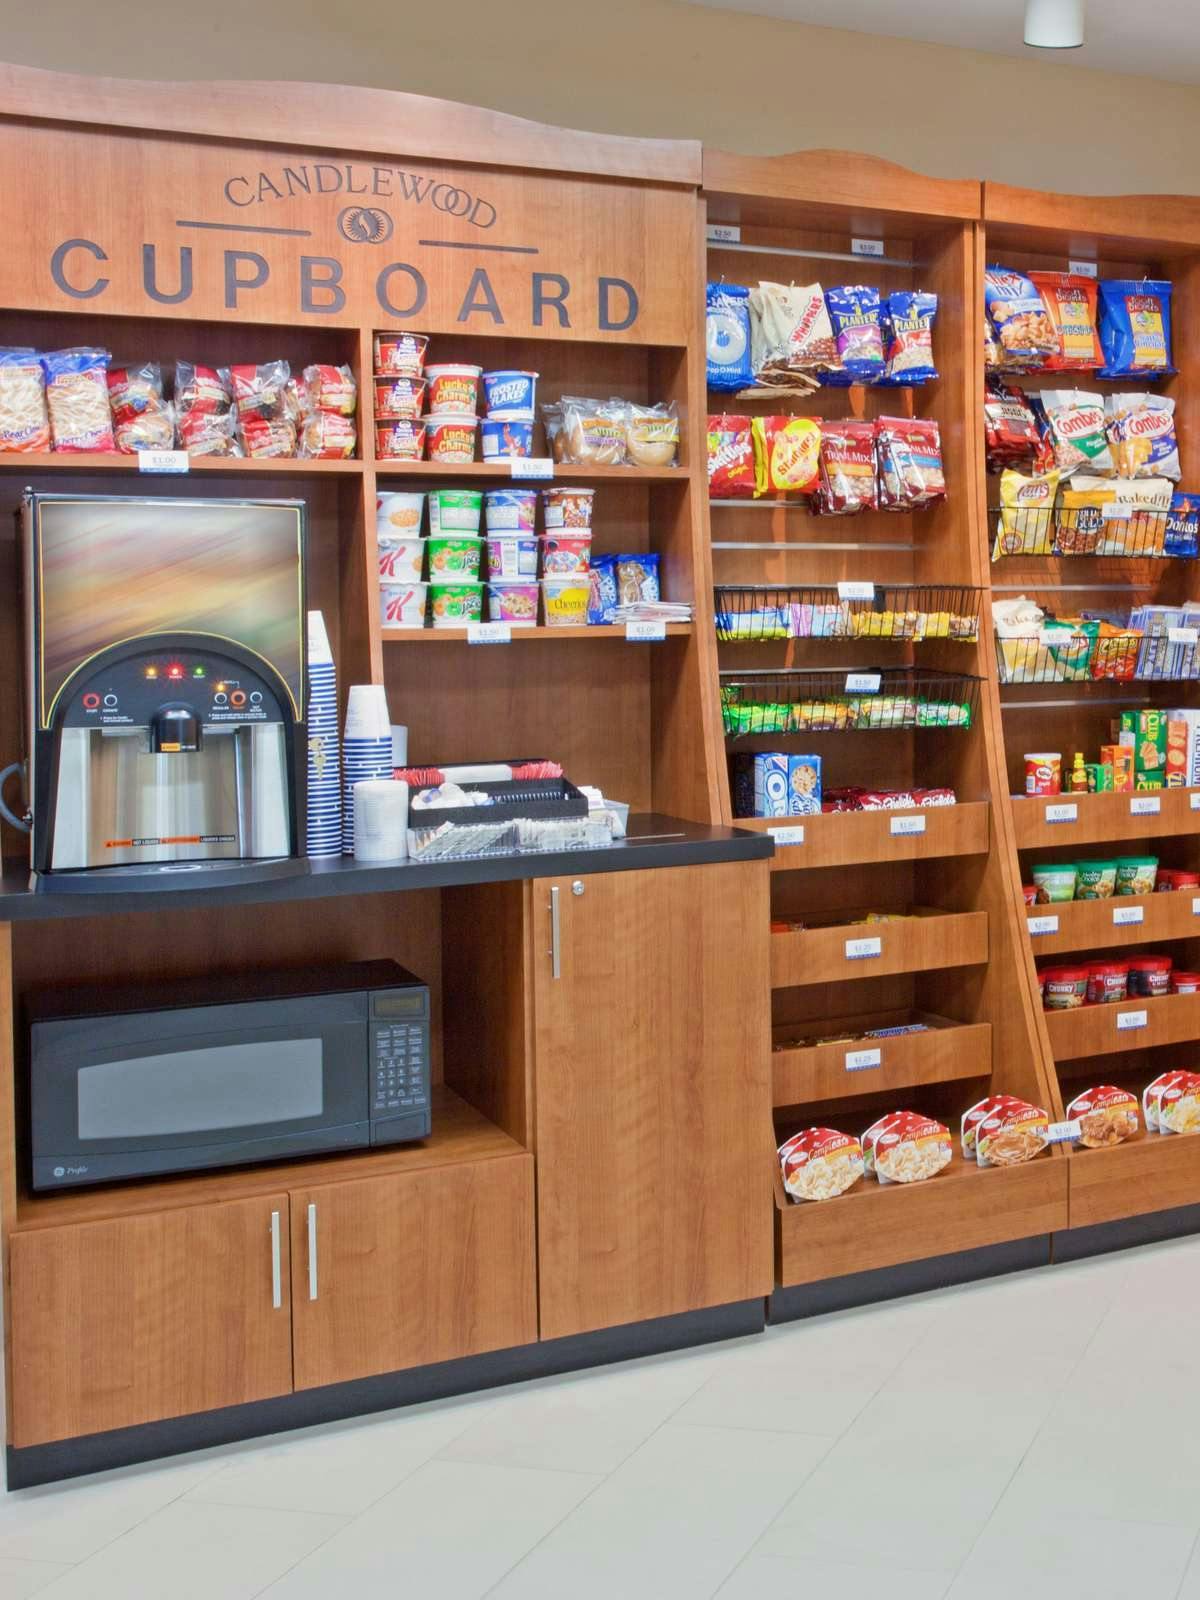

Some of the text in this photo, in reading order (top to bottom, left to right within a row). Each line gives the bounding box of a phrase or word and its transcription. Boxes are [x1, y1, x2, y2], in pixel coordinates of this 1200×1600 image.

[224, 164, 497, 229] CANDLEWOOD
[50, 237, 640, 331] CUPBOARD
[895, 316, 930, 332] PLANTER
[438, 379, 470, 391] Lucky
[489, 379, 529, 398] FROSTED
[435, 389, 471, 405] Charms
[490, 390, 526, 406] FLAKES
[1166, 517, 1199, 534] Doritos
[379, 546, 406, 577] K
[386, 591, 414, 621] K
[554, 599, 587, 609] Cheerios
